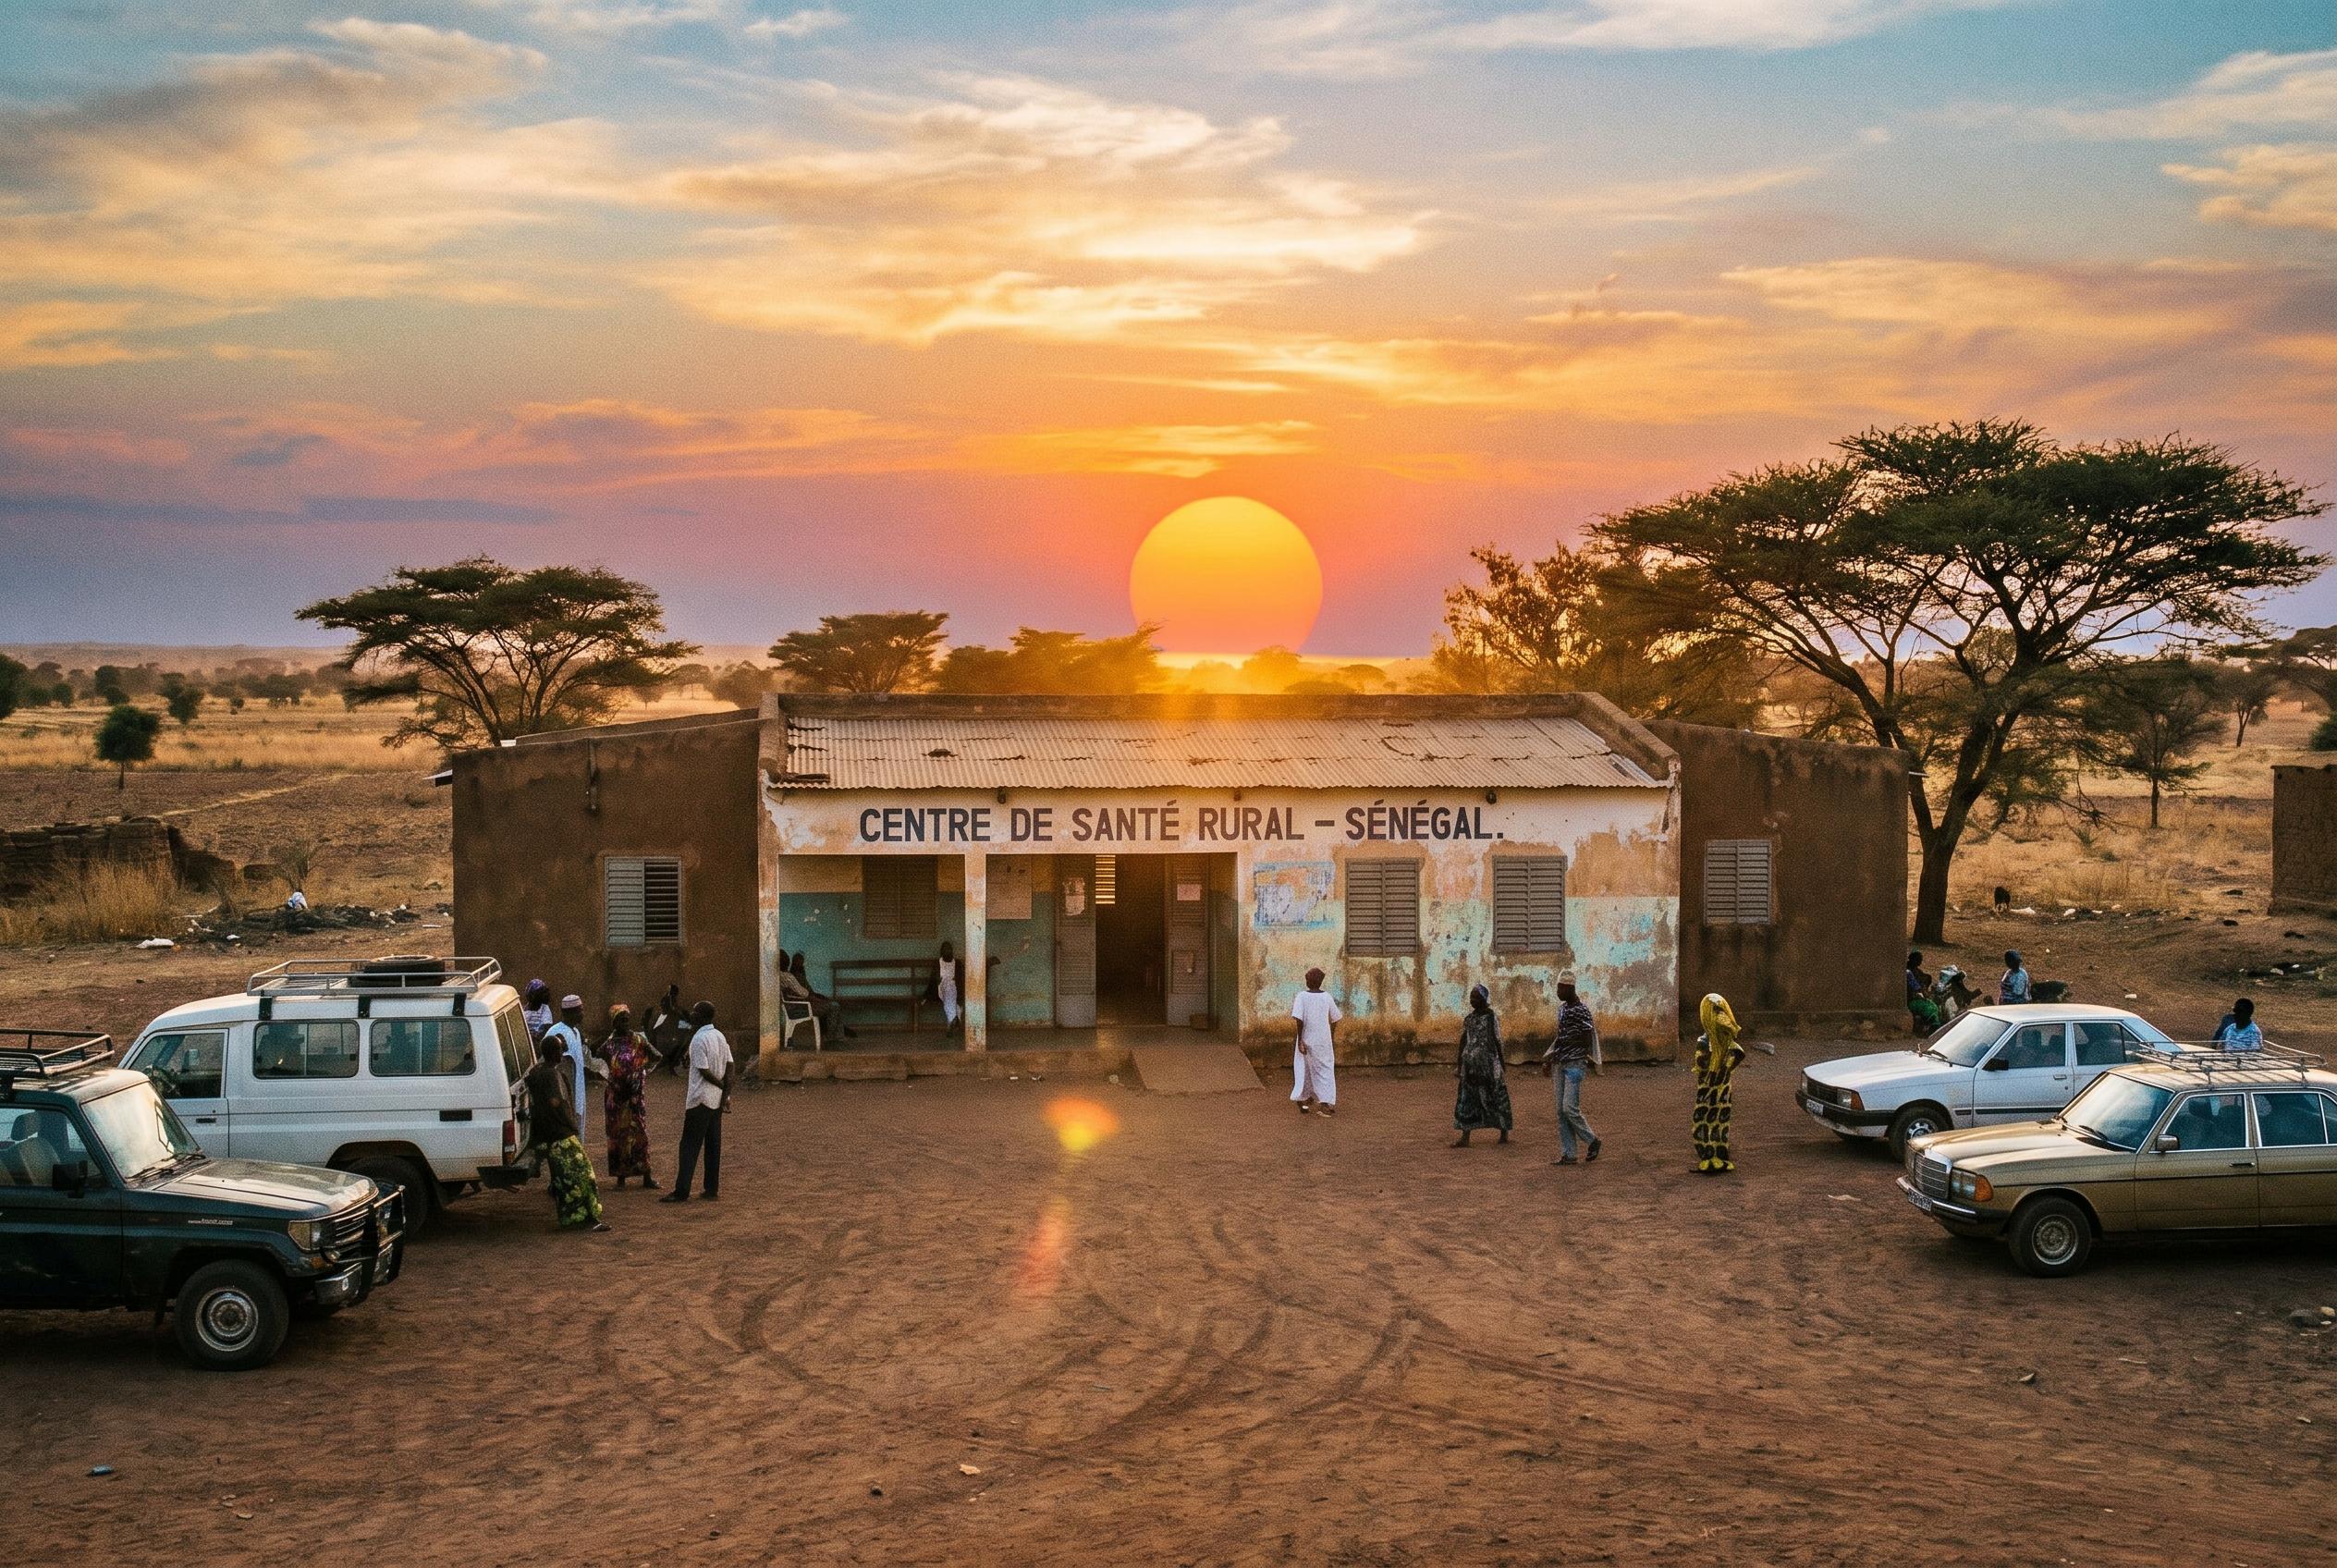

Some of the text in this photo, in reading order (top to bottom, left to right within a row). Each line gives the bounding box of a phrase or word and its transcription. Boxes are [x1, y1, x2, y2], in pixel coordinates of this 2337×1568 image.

[860, 808, 991, 842] CENTRE
[1010, 808, 1053, 842] DE
[1071, 799, 1180, 841] SANTÉ
[1198, 807, 1304, 841] RURAL
[1345, 799, 1504, 840] SÉNÉGAL.
